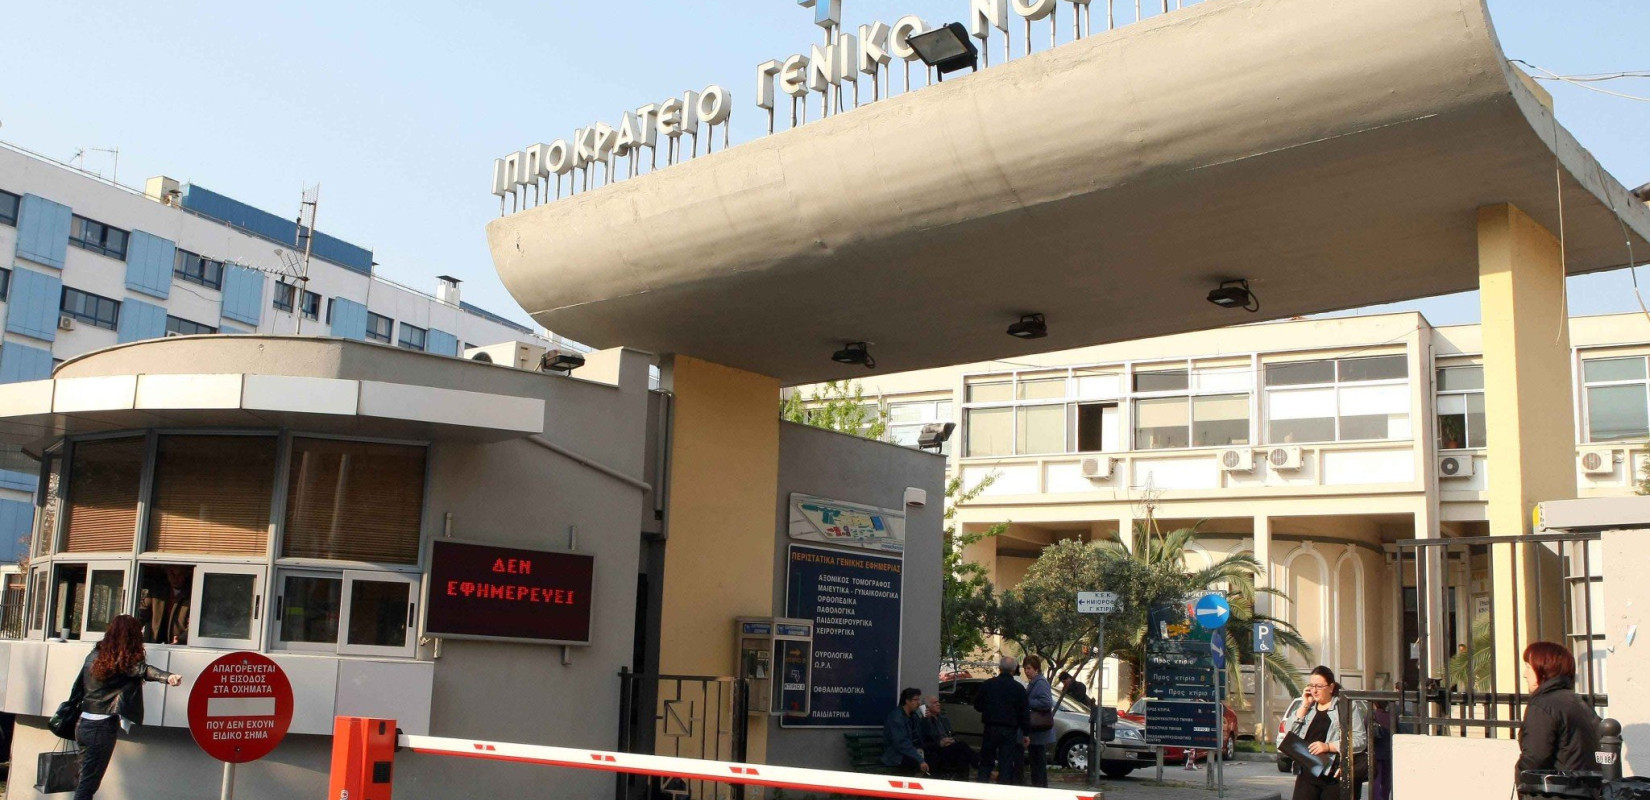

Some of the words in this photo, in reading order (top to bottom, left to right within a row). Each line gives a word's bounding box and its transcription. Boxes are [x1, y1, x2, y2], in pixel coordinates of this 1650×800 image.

[492, 84, 732, 195] ΙΠΠΟΚΡΑΤΕΙΟ
[757, 15, 931, 111] ΓΕΝΙΚΟ
[971, 0, 1091, 39] ΝΟ
[492, 557, 532, 574] ΔΕΝ
[792, 552, 835, 564] ΠΕΡΙΣΤΑΤΙΚΑ
[836, 558, 864, 568] ΓΕΝΙΚΗΣ
[865, 561, 901, 572] ΕΦΗΜΕΡΙΑΣ
[818, 574, 849, 584] ΑΞΟΝΙΚΟΣ
[852, 577, 891, 588] ΤΟΜΟΓΡΑΦΟΣ
[447, 580, 576, 604] ΕΦΗΜΕΡΕΥΕΙ
[818, 584, 850, 594] ΜΑΙΕΥΤΙΚΑ
[854, 588, 899, 599] ΓΥΝΑΙΚΟΛΟΓΙΚΑ
[817, 595, 857, 605] ΟΡΘΟΠΕΔΙΚΑ
[816, 606, 856, 615] ΠΑΘΟΛΟΓΙΚΑ
[816, 616, 873, 627] ΠΑΙΔΟΧΕΙΡΟΥΡΓΙΚΑ
[816, 627, 855, 636] ΧΕΙΡΟΥΡΓΙΚΑ
[1258, 625, 1269, 640] P
[814, 650, 853, 659] ΟΥΡΟΛΟΓΙΚΑ
[212, 664, 276, 673] ΑΠΑΓΟΡΕΥΕΤΑΙ
[221, 675, 227, 683] Η
[229, 675, 266, 683] ΕΙΣΟΔΟΣ
[213, 685, 229, 694] ΣΤΑ
[231, 685, 272, 693] ΟΧΗΜΑΤΑ
[813, 686, 865, 694] ΟΦΘΑΛΜΟΛΟΓΙΚΑ
[812, 710, 850, 718] ΠΑΙΔΙΑΤΡΙΚΑ
[206, 721, 225, 730] ΠΟΥ
[226, 721, 244, 729] ΔΕΝ
[246, 720, 274, 729] ΕΧΟΥΝ
[213, 731, 242, 740] ΕΙΔΙΚΟ
[244, 731, 268, 740] ΣΗΜΑ
